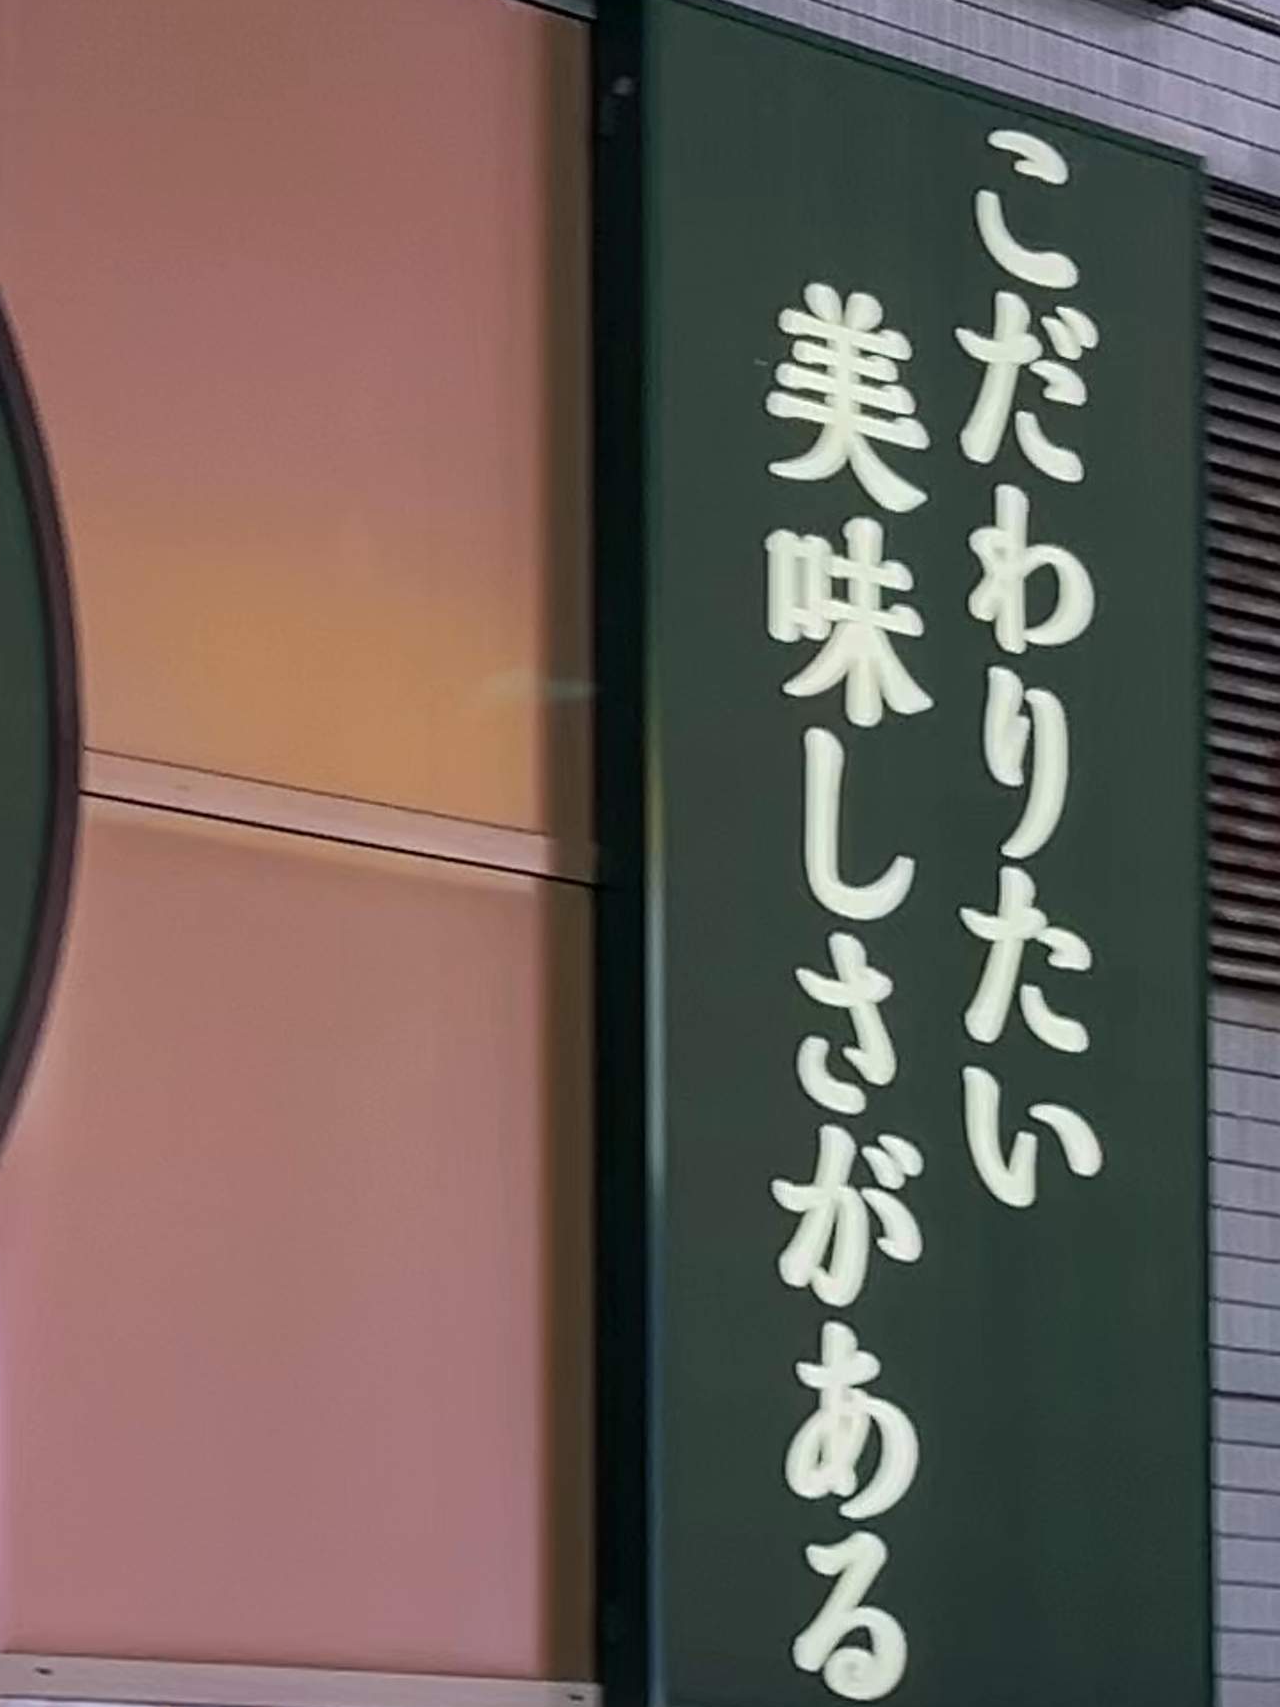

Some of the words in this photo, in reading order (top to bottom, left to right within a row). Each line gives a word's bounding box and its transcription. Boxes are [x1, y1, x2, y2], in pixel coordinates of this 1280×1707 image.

[764, 282, 934, 1704] 美味しさがある
[953, 128, 1105, 1210] こだわりたい
